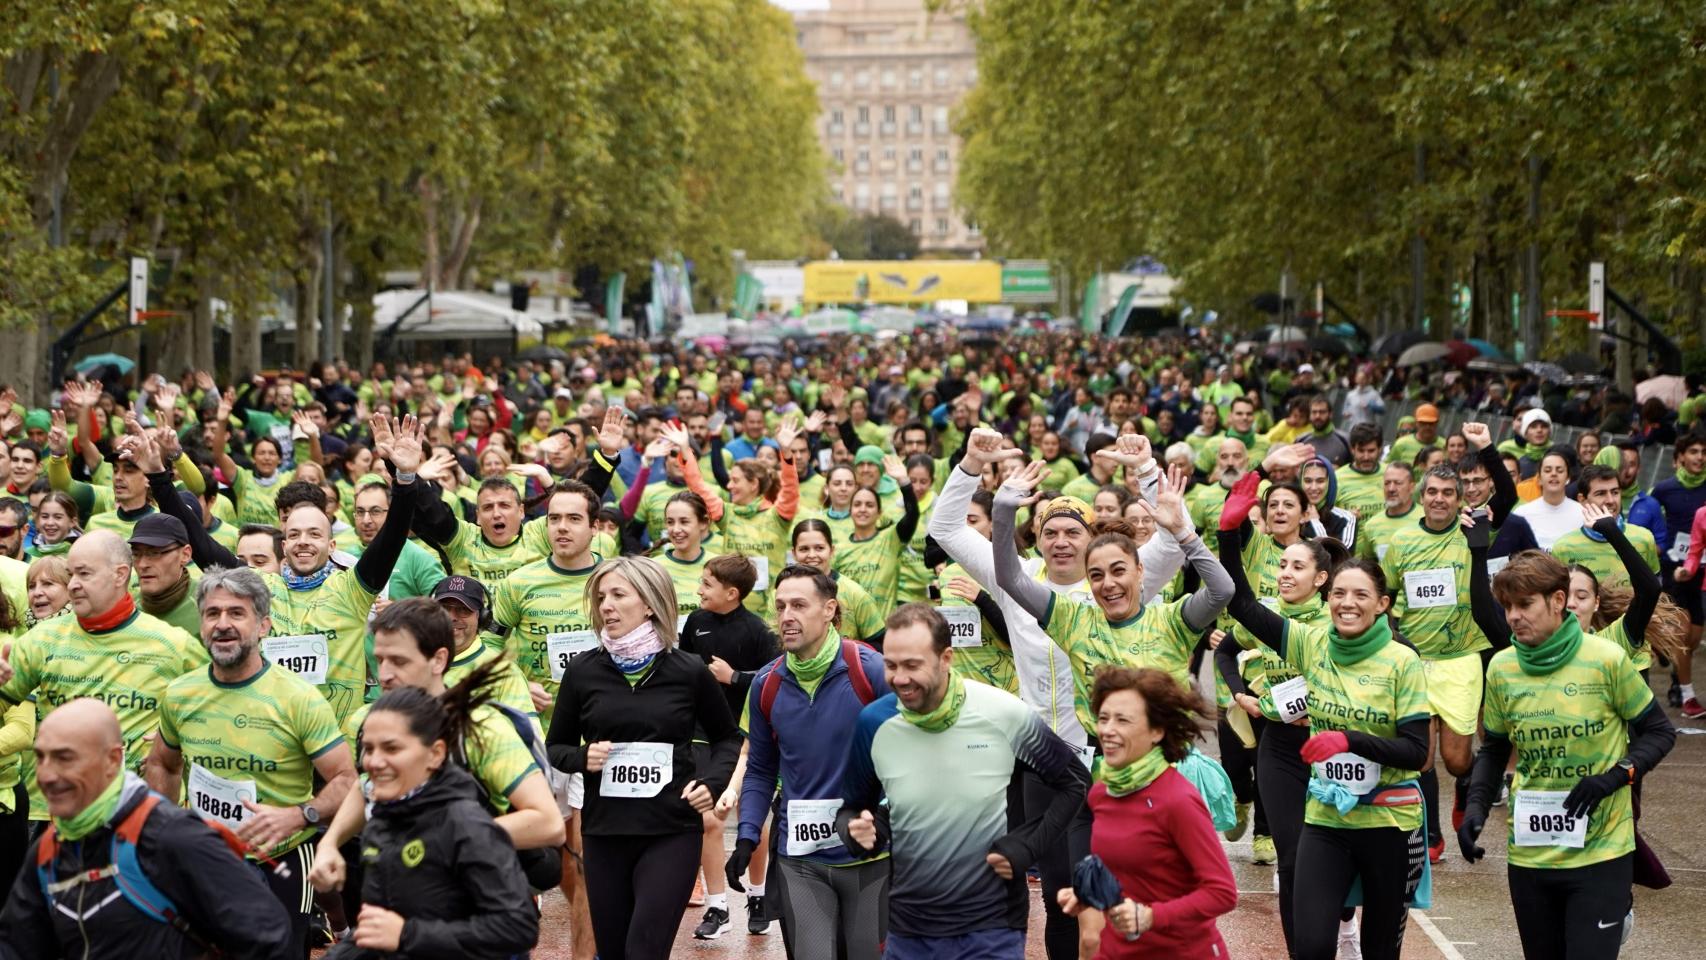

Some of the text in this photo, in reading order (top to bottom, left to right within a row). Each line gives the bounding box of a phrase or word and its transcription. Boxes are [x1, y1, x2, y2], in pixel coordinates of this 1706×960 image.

[1416, 585, 1445, 598] 4692
[540, 608, 578, 616] Valladolid
[529, 622, 549, 636] En
[73, 690, 157, 711] archa
[1306, 690, 1390, 725] En marcha
[1530, 719, 1605, 741] marcha
[192, 754, 278, 773] marcha
[1325, 761, 1366, 781] 8036
[611, 765, 662, 784] 18695
[195, 791, 244, 822] 18884
[1529, 814, 1576, 832] 8035
